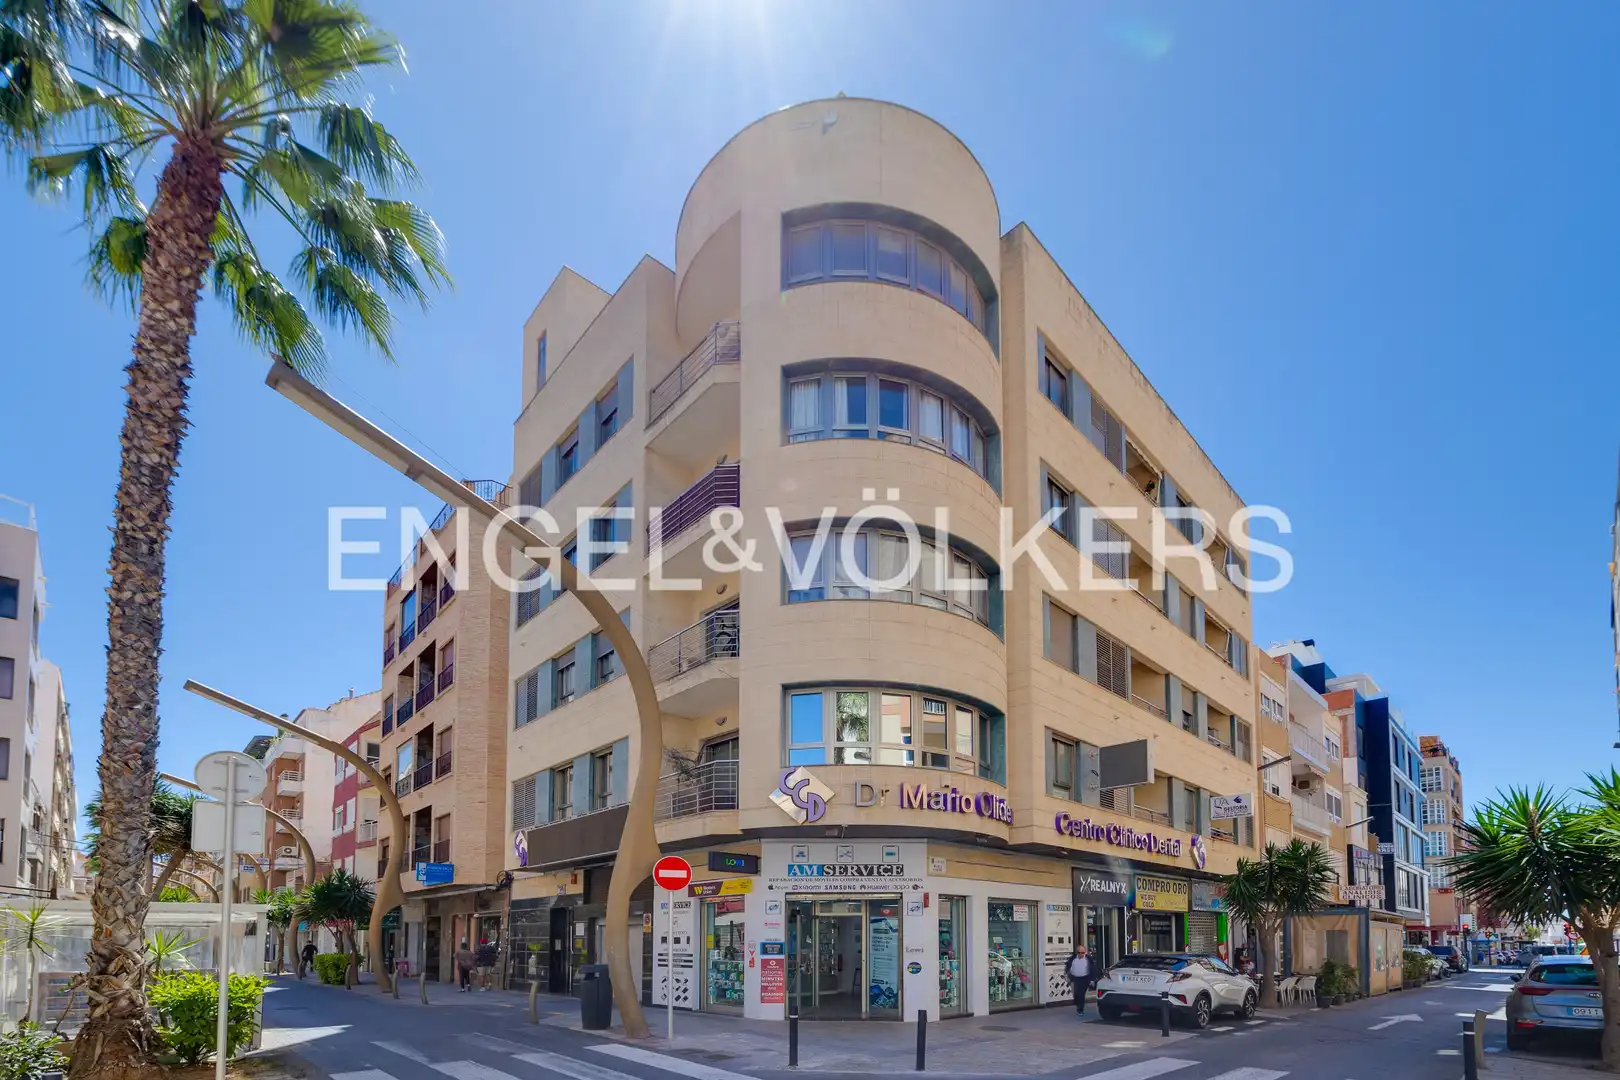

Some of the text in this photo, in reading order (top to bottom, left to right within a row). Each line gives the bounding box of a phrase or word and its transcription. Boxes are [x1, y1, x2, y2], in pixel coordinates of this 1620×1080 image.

[855, 781, 890, 807] Dr
[900, 782, 974, 813] Mario
[1055, 811, 1105, 842] Centro
[1147, 833, 1183, 858] Dental
[788, 864, 904, 876] AM SERVICE
[1090, 878, 1127, 894] REALNYX
[1136, 877, 1171, 894] COMPRO
[1173, 881, 1188, 895] ORO
